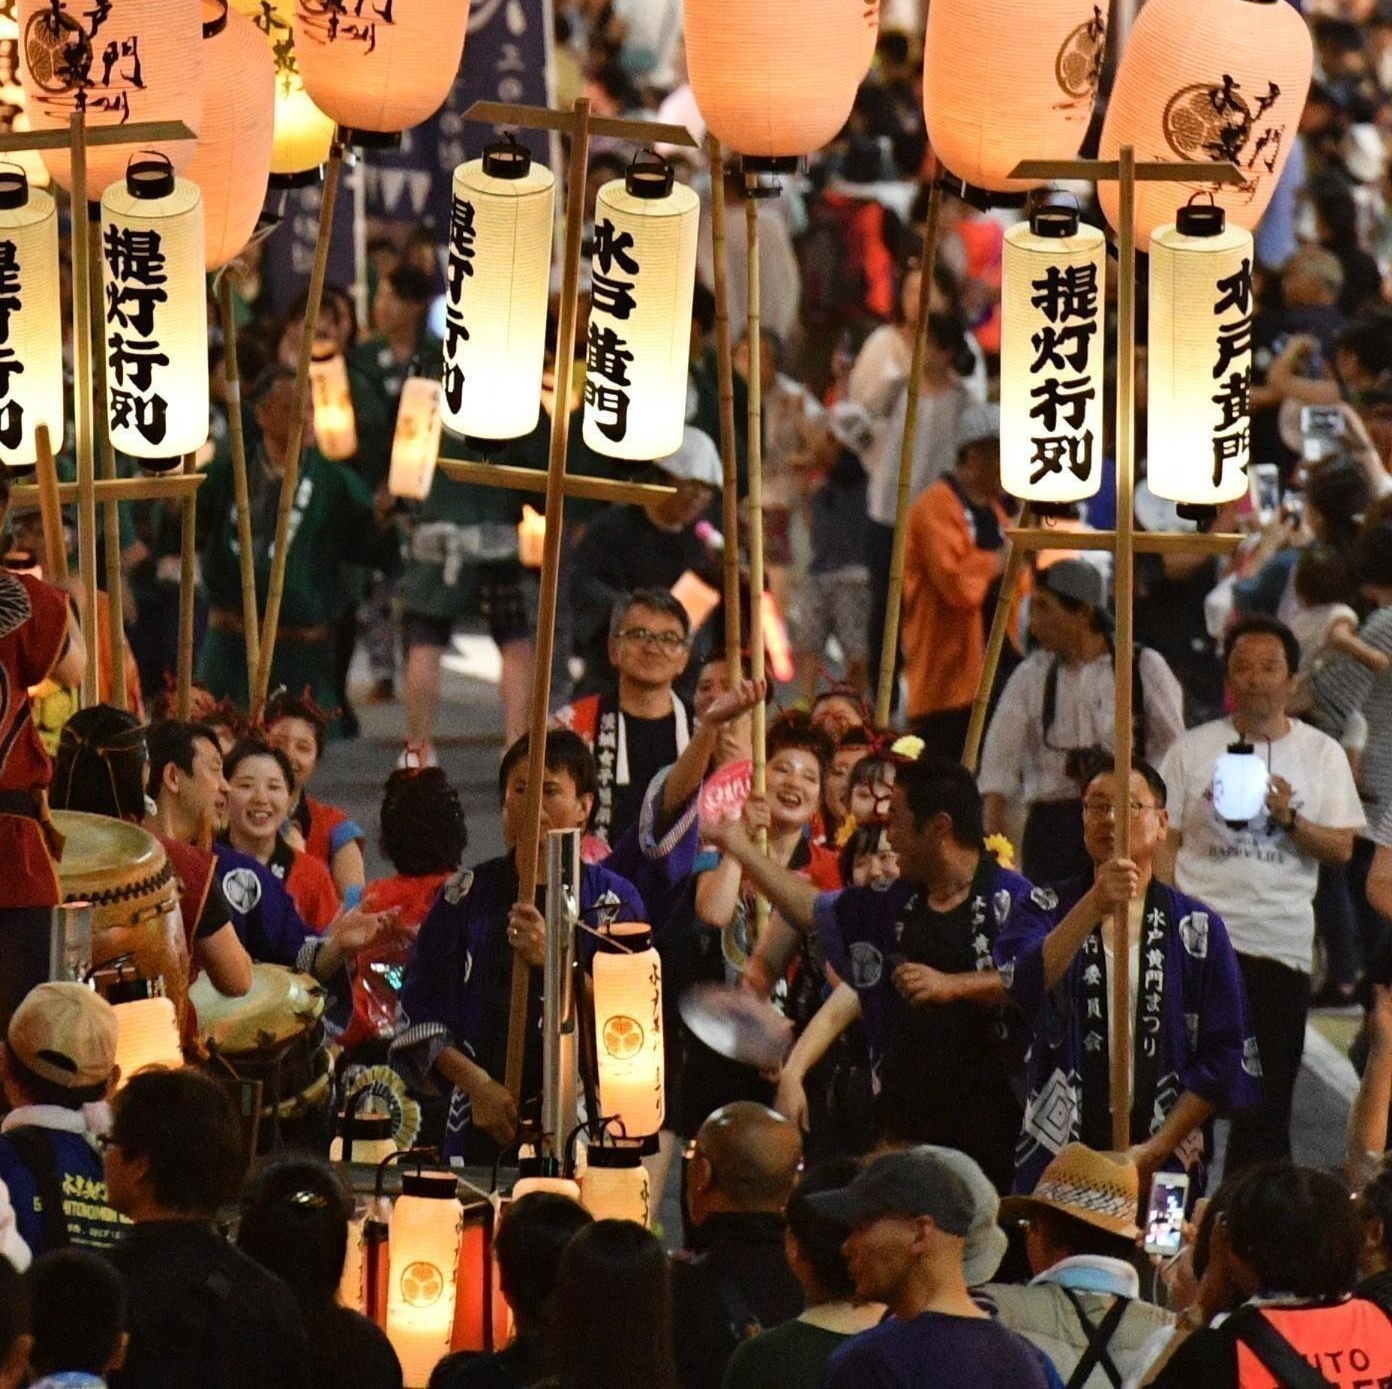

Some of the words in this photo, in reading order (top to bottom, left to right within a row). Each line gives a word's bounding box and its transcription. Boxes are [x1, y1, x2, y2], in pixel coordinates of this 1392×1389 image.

[104, 223, 170, 445] 提灯行列
[585, 218, 640, 442] 水戸黄門
[1029, 261, 1098, 485] 提灯行列
[1143, 907, 1167, 1057] 水戸黄門まつり
[1302, 1349, 1370, 1374] ITO
